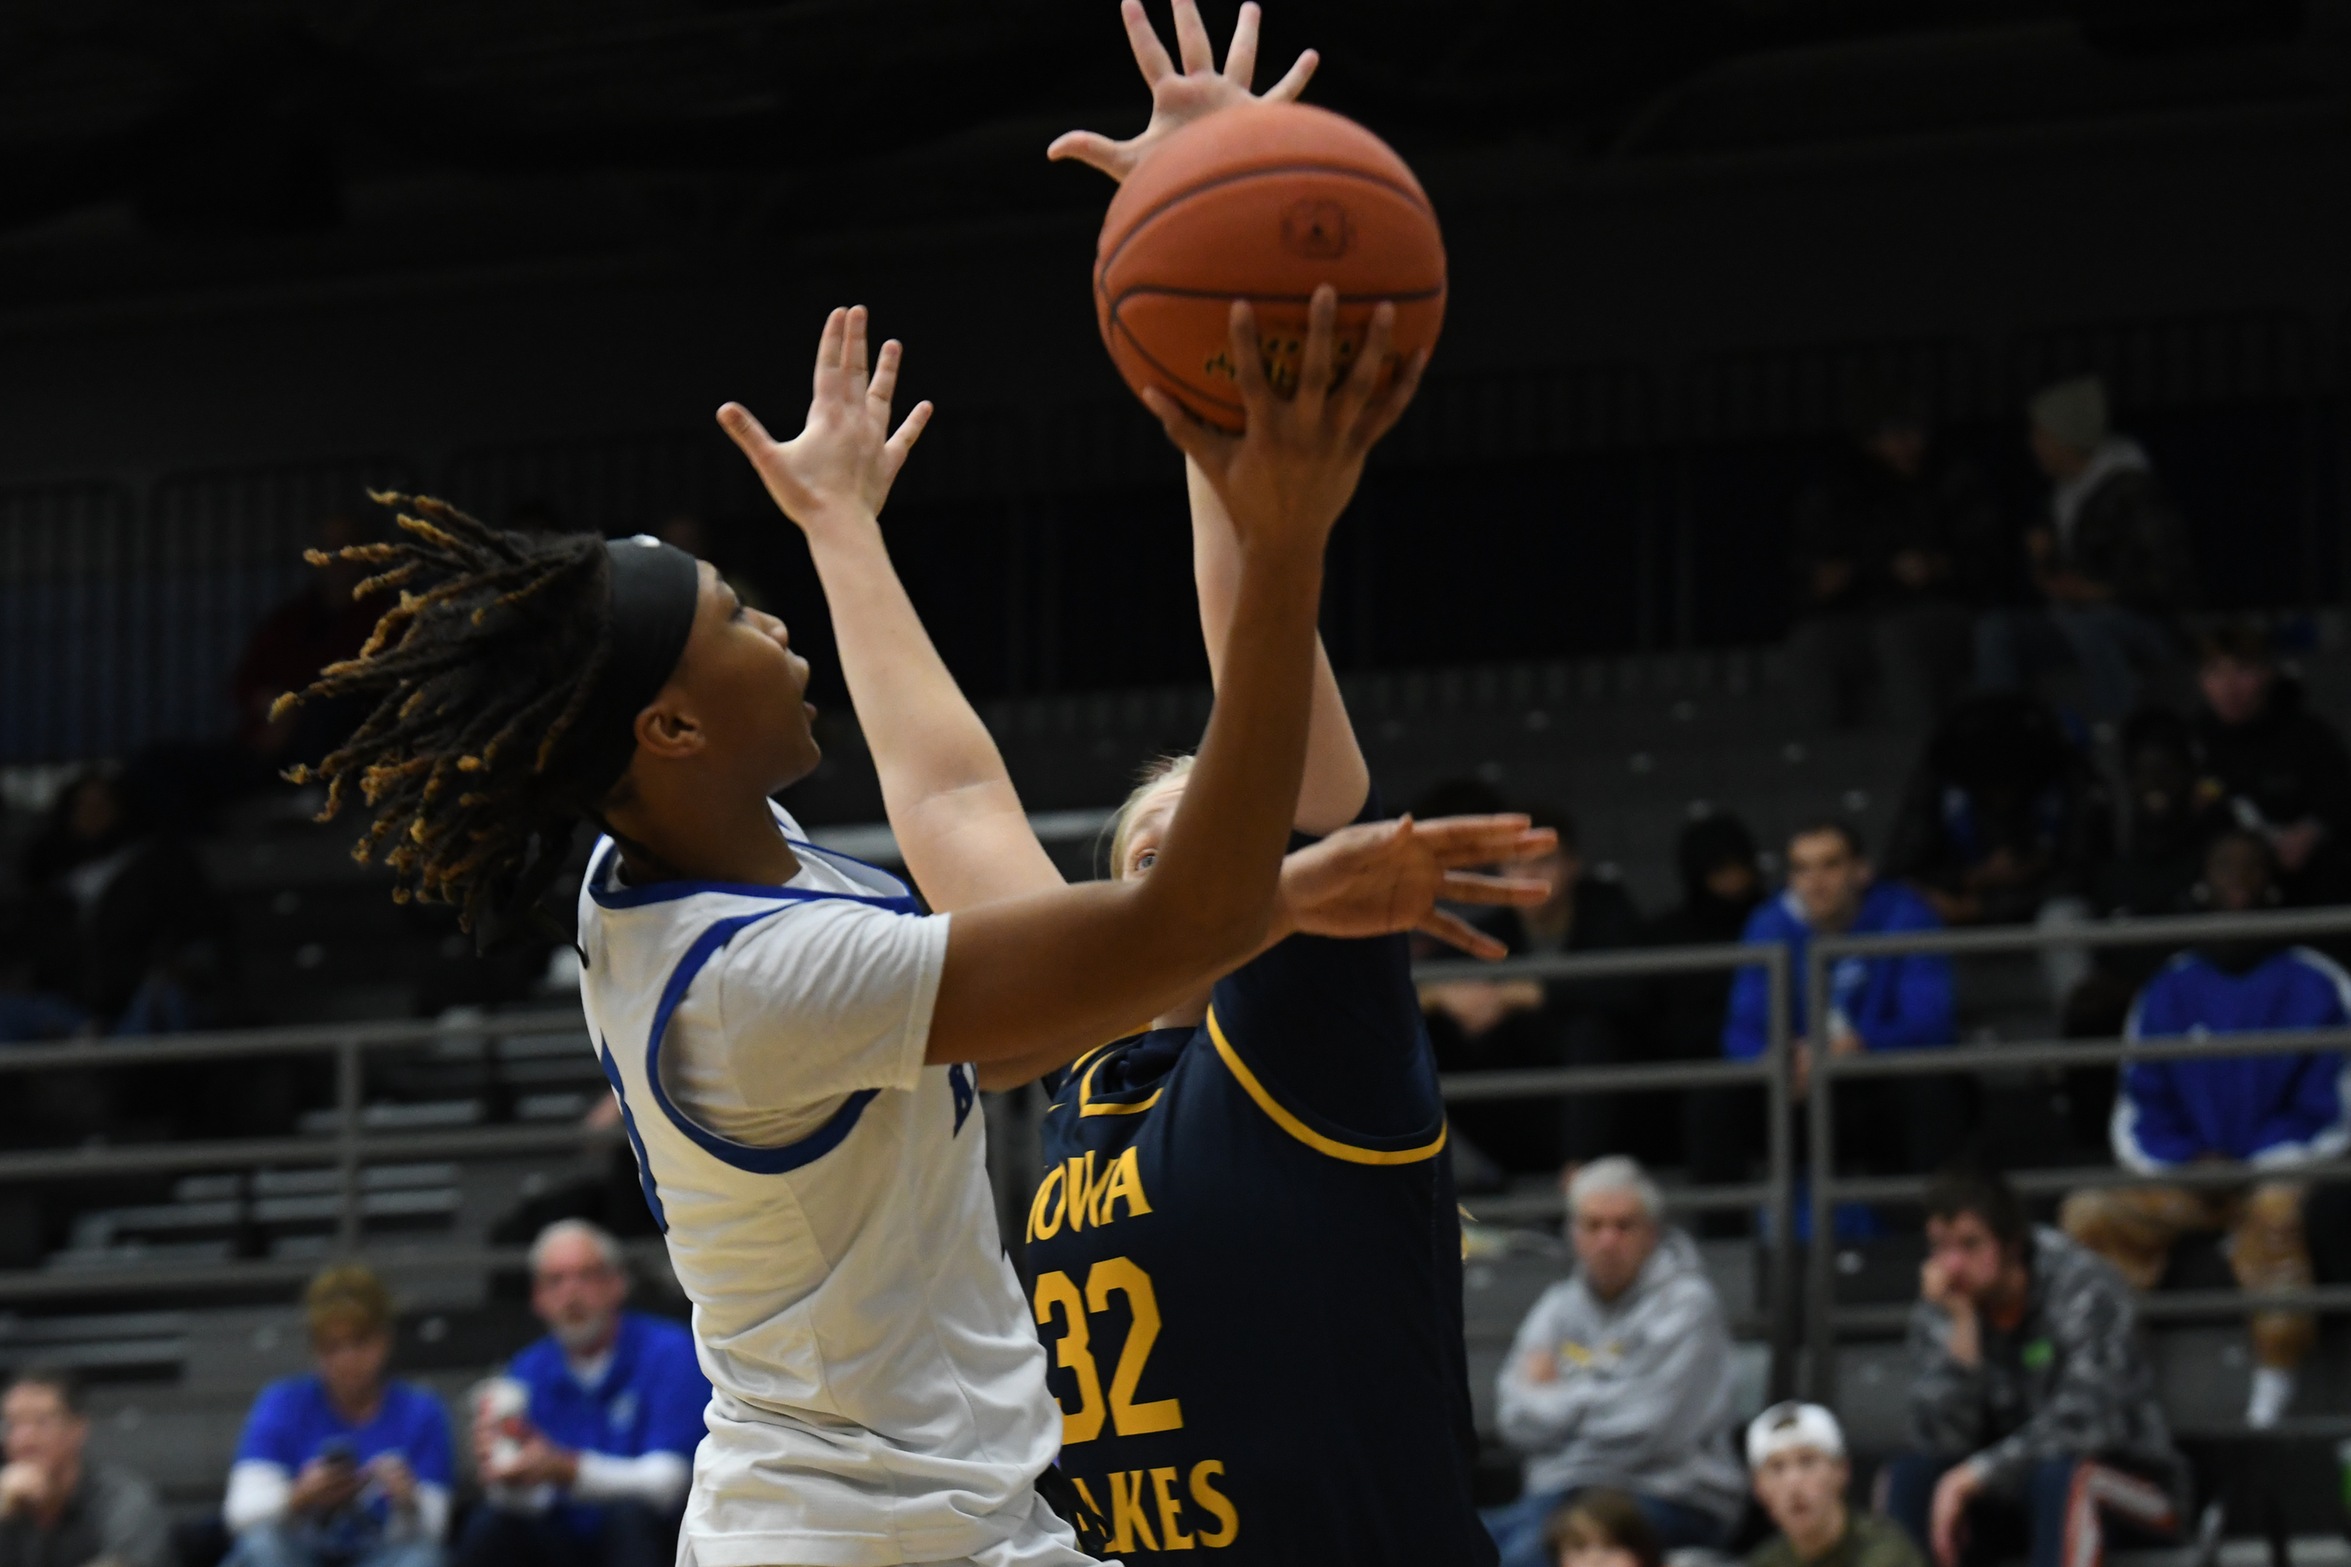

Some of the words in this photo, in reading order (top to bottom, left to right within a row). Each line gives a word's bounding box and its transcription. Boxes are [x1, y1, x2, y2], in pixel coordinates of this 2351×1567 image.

[1025, 1145, 1153, 1244] IOWA
[1033, 1256, 1184, 1446] 32
[1071, 1459, 1240, 1554] AKES
